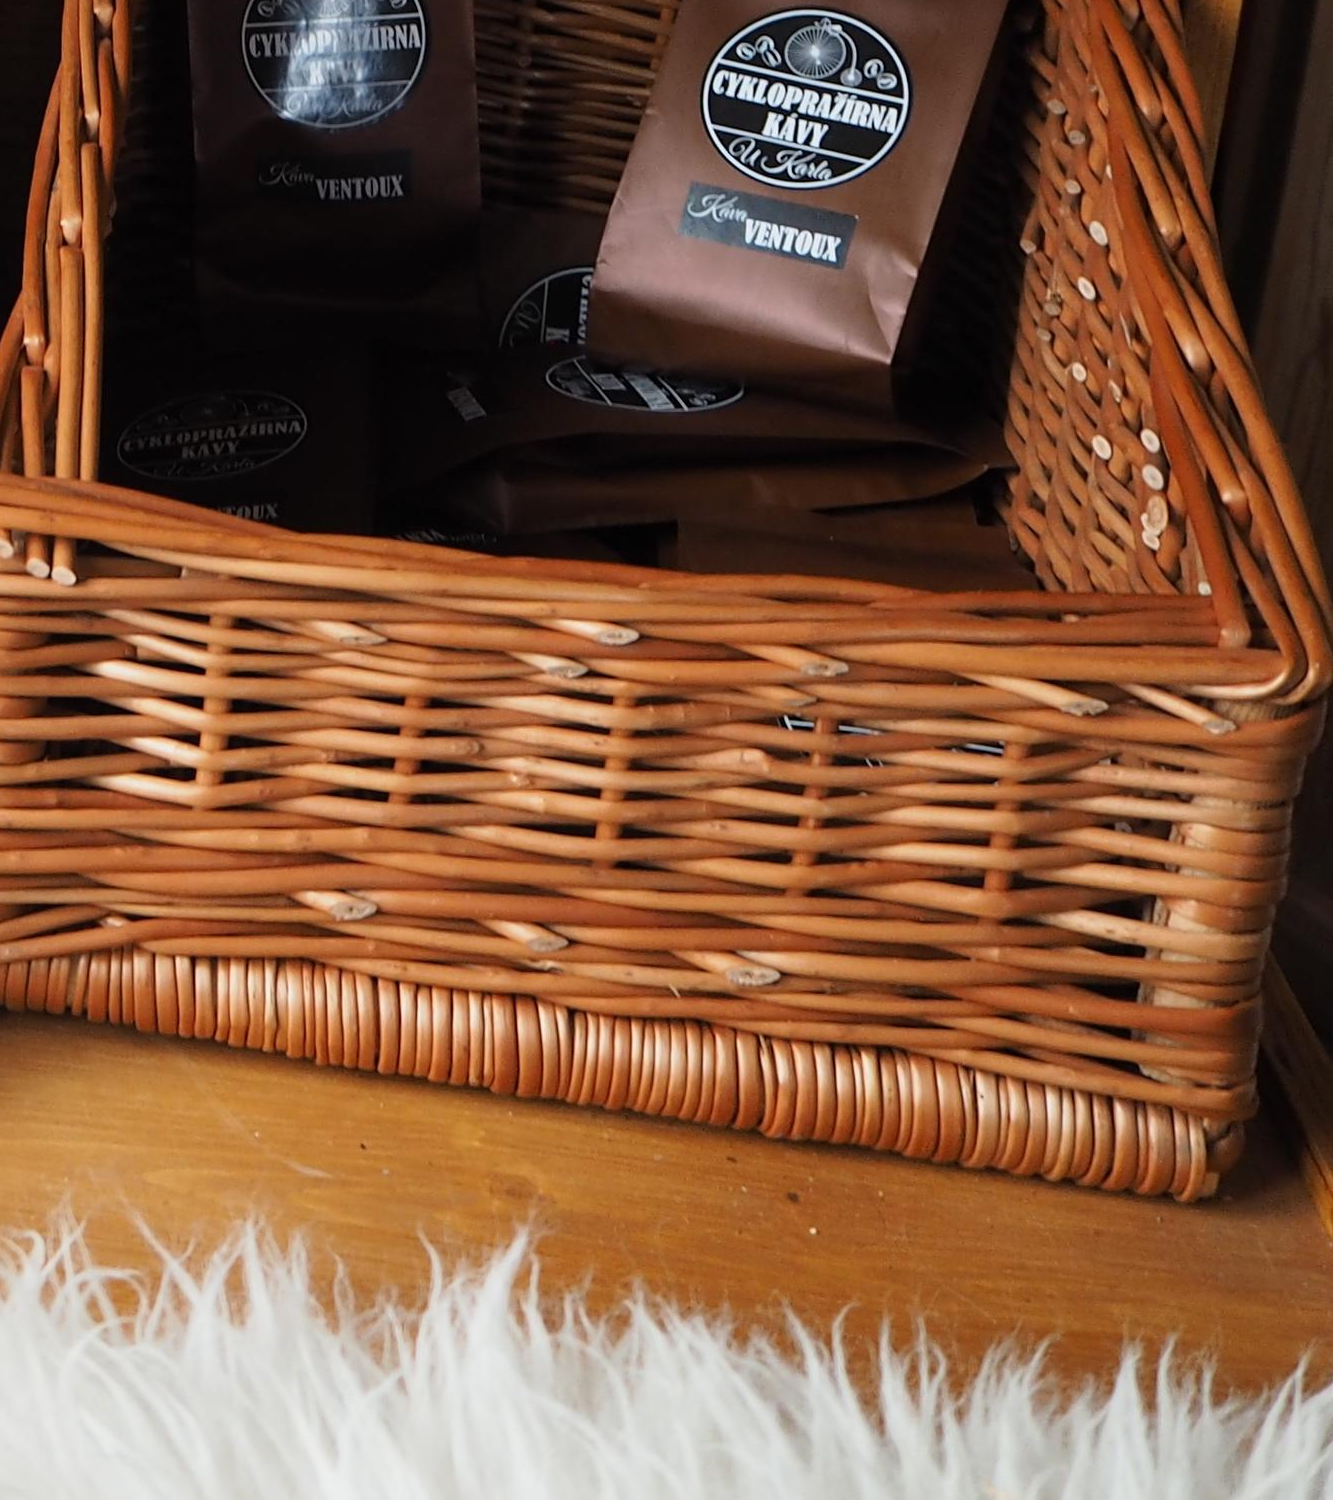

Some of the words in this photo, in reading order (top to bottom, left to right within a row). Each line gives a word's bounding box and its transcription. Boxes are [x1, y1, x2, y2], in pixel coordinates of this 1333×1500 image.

[711, 68, 900, 134] CYKLOPRAŽÍRNA
[761, 111, 830, 149] KÁVY
[728, 136, 762, 168] U
[760, 149, 834, 181] Karla
[316, 174, 405, 201] VENTOUX
[686, 193, 748, 223] Káva
[744, 219, 842, 263] VENTOUX
